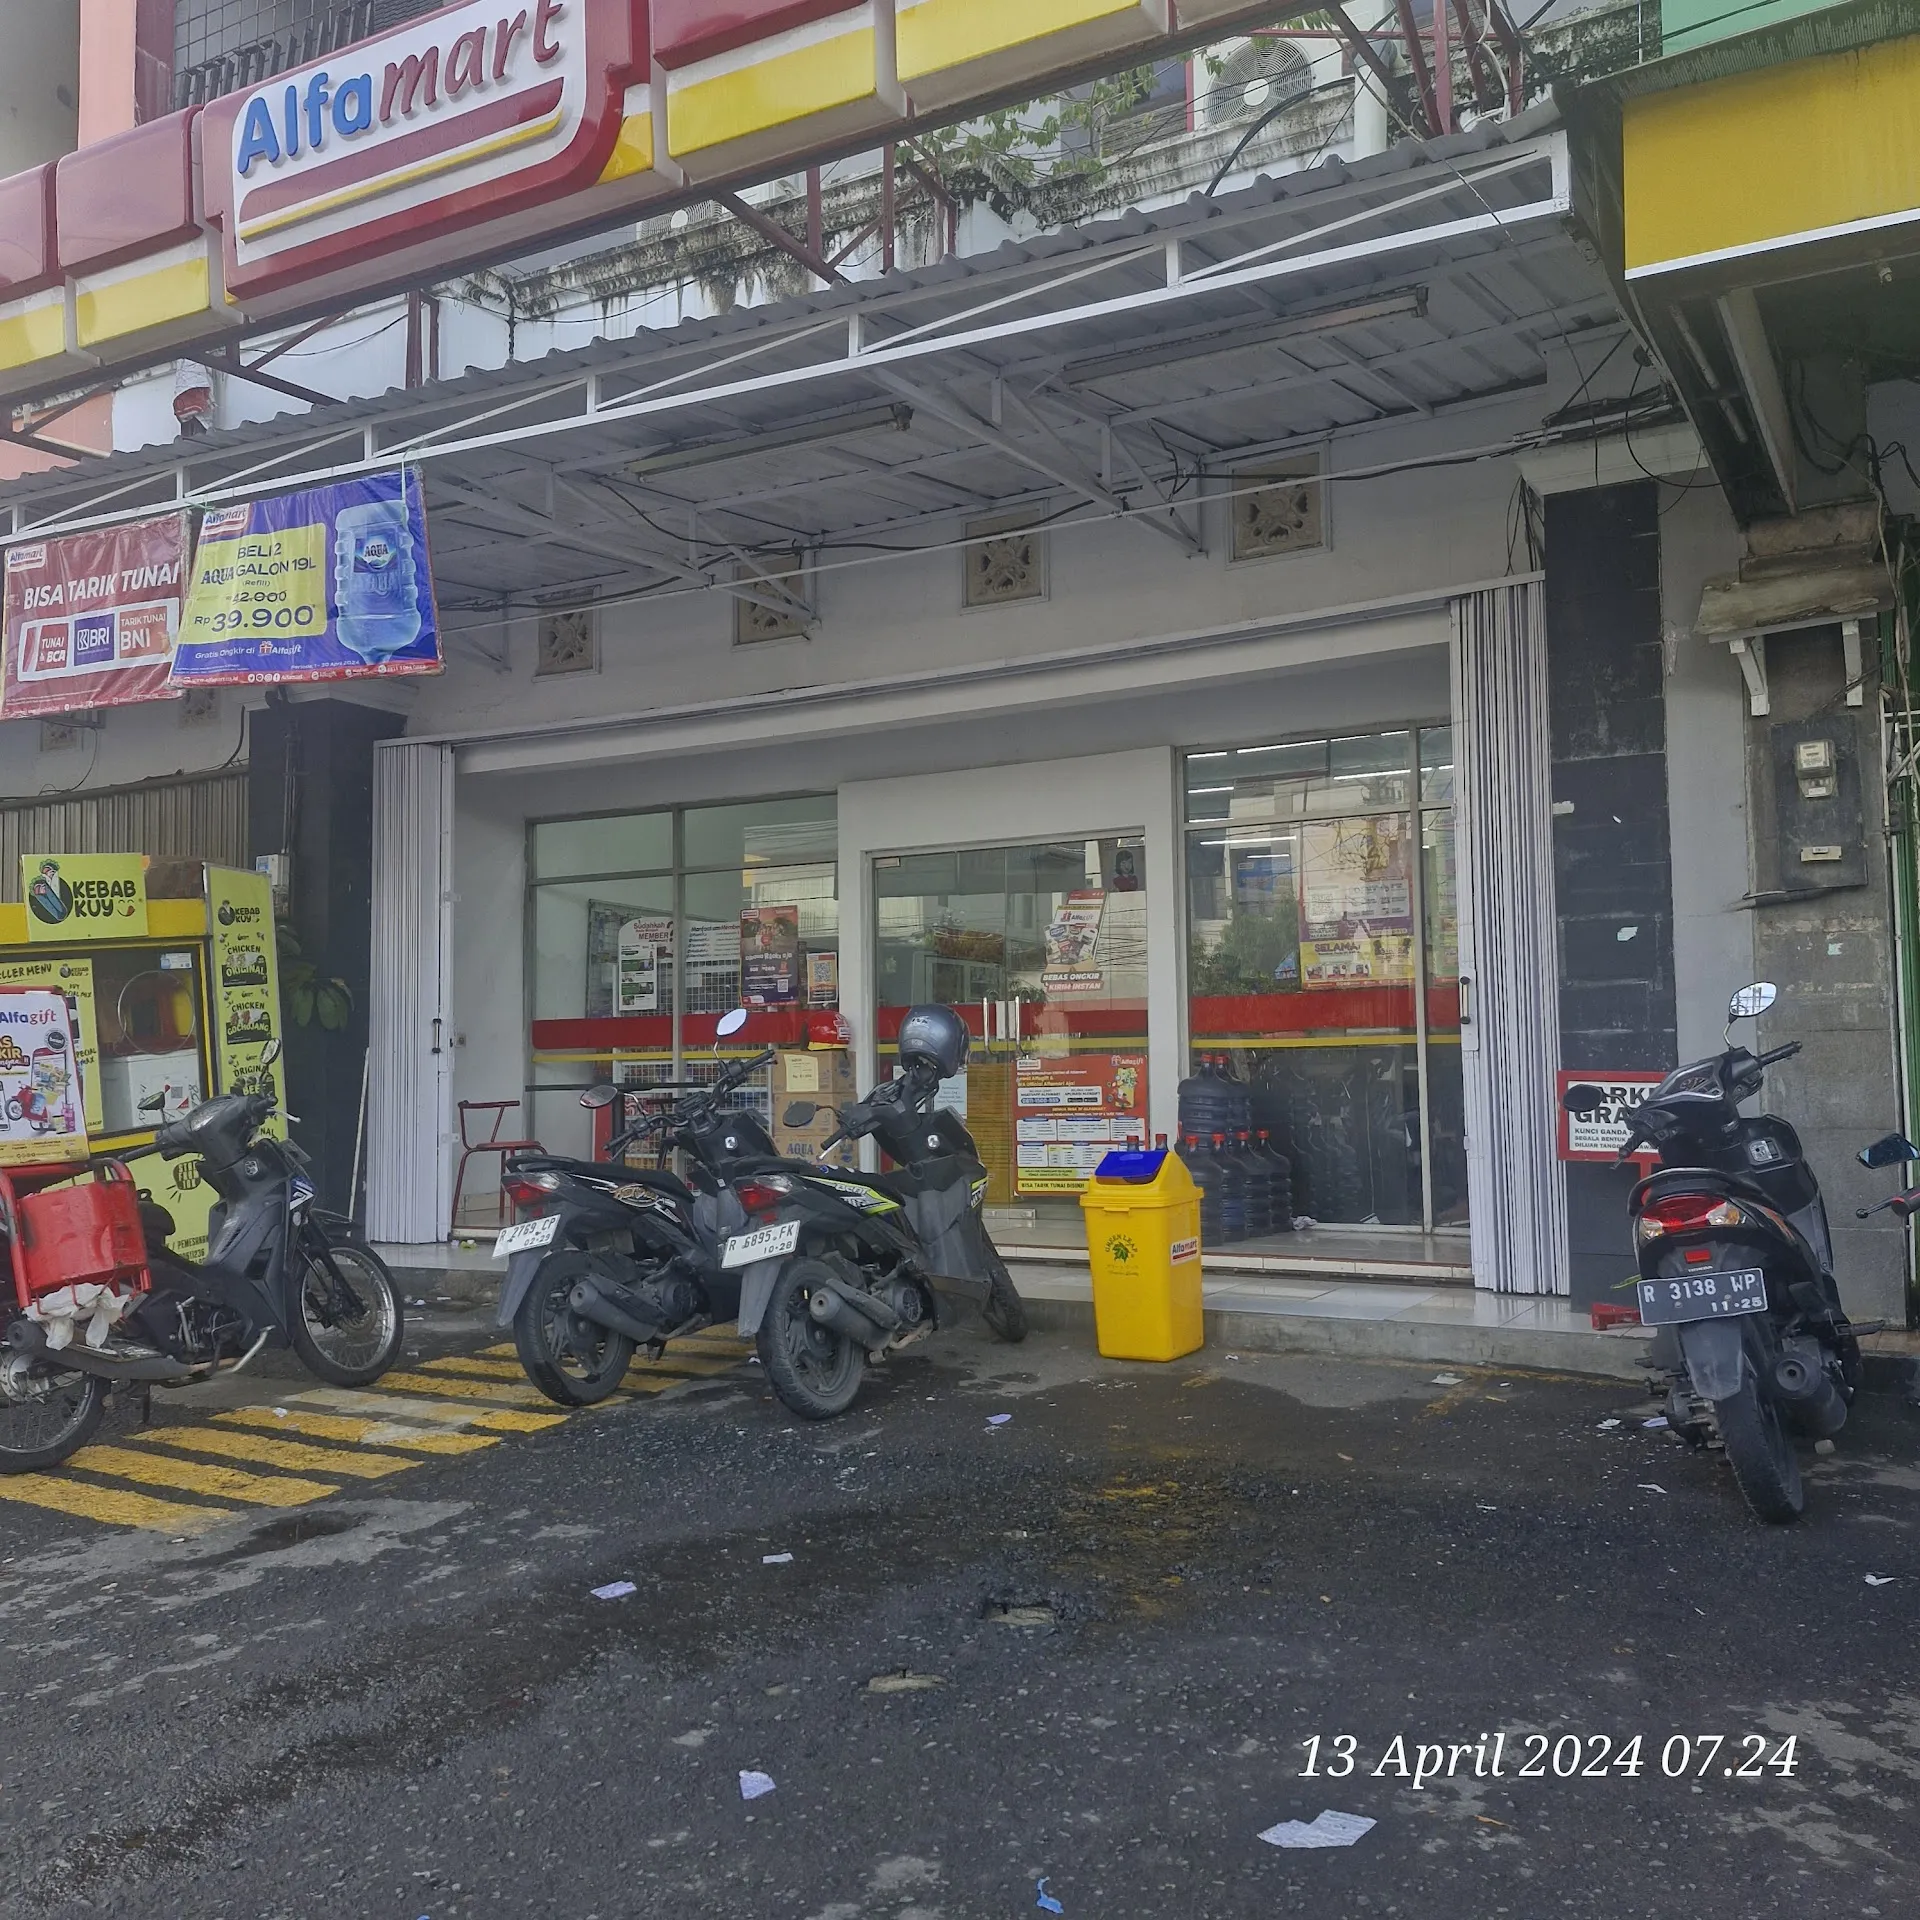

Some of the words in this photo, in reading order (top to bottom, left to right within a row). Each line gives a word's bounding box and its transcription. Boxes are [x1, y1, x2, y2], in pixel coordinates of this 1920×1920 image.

[237, 0, 563, 175] Alfamart
[10, 548, 43, 563] Alfamart
[237, 545, 272, 559] BELI
[273, 542, 282, 555] 2
[364, 544, 389, 557] AQUA
[200, 566, 235, 585] AQUA
[236, 561, 289, 577] GALON
[292, 557, 316, 570] 19L
[23, 584, 64, 610] BISA
[67, 573, 119, 602] TARIK
[121, 562, 180, 593] TUNAI
[121, 616, 142, 627] TARIK
[142, 612, 166, 623] TUNAI
[194, 616, 211, 627] Rp
[41, 637, 64, 649] TUNAI
[90, 626, 110, 645] BRI
[120, 628, 150, 650] BNI
[46, 650, 66, 664] BCA
[195, 649, 219, 660] Gratis
[219, 645, 245, 657] Ongkir
[245, 646, 255, 654] di
[271, 644, 302, 656] Alfagift
[72, 880, 136, 899] KEBAB
[74, 899, 114, 918] KUY
[235, 907, 261, 915] KEBAB
[639, 931, 669, 939] MEMBER
[227, 945, 261, 955] CHICKEN
[26, 963, 52, 976] MENU
[226, 964, 265, 977] ORIGINAL
[1042, 973, 1069, 981] BEBAS
[1070, 972, 1100, 980] ONGKIR
[1049, 983, 1072, 991] KIRIM
[1072, 982, 1101, 990] INSTAN
[231, 1002, 265, 1013] CHICKEN
[0, 1008, 57, 1025] Alfagift
[243, 1084, 261, 1096] BEE
[786, 1142, 815, 1157] AQUA
[500, 1230, 507, 1241] R
[511, 1222, 537, 1239] 2769
[541, 1217, 556, 1231] CP
[729, 1239, 736, 1251] R
[743, 1229, 772, 1249] 6895
[779, 1224, 794, 1239] FK
[1172, 1239, 1198, 1254] Alfamart
[1643, 1286, 1655, 1303] R
[1668, 1278, 1717, 1300] 3138
[1730, 1273, 1756, 1293] WP
